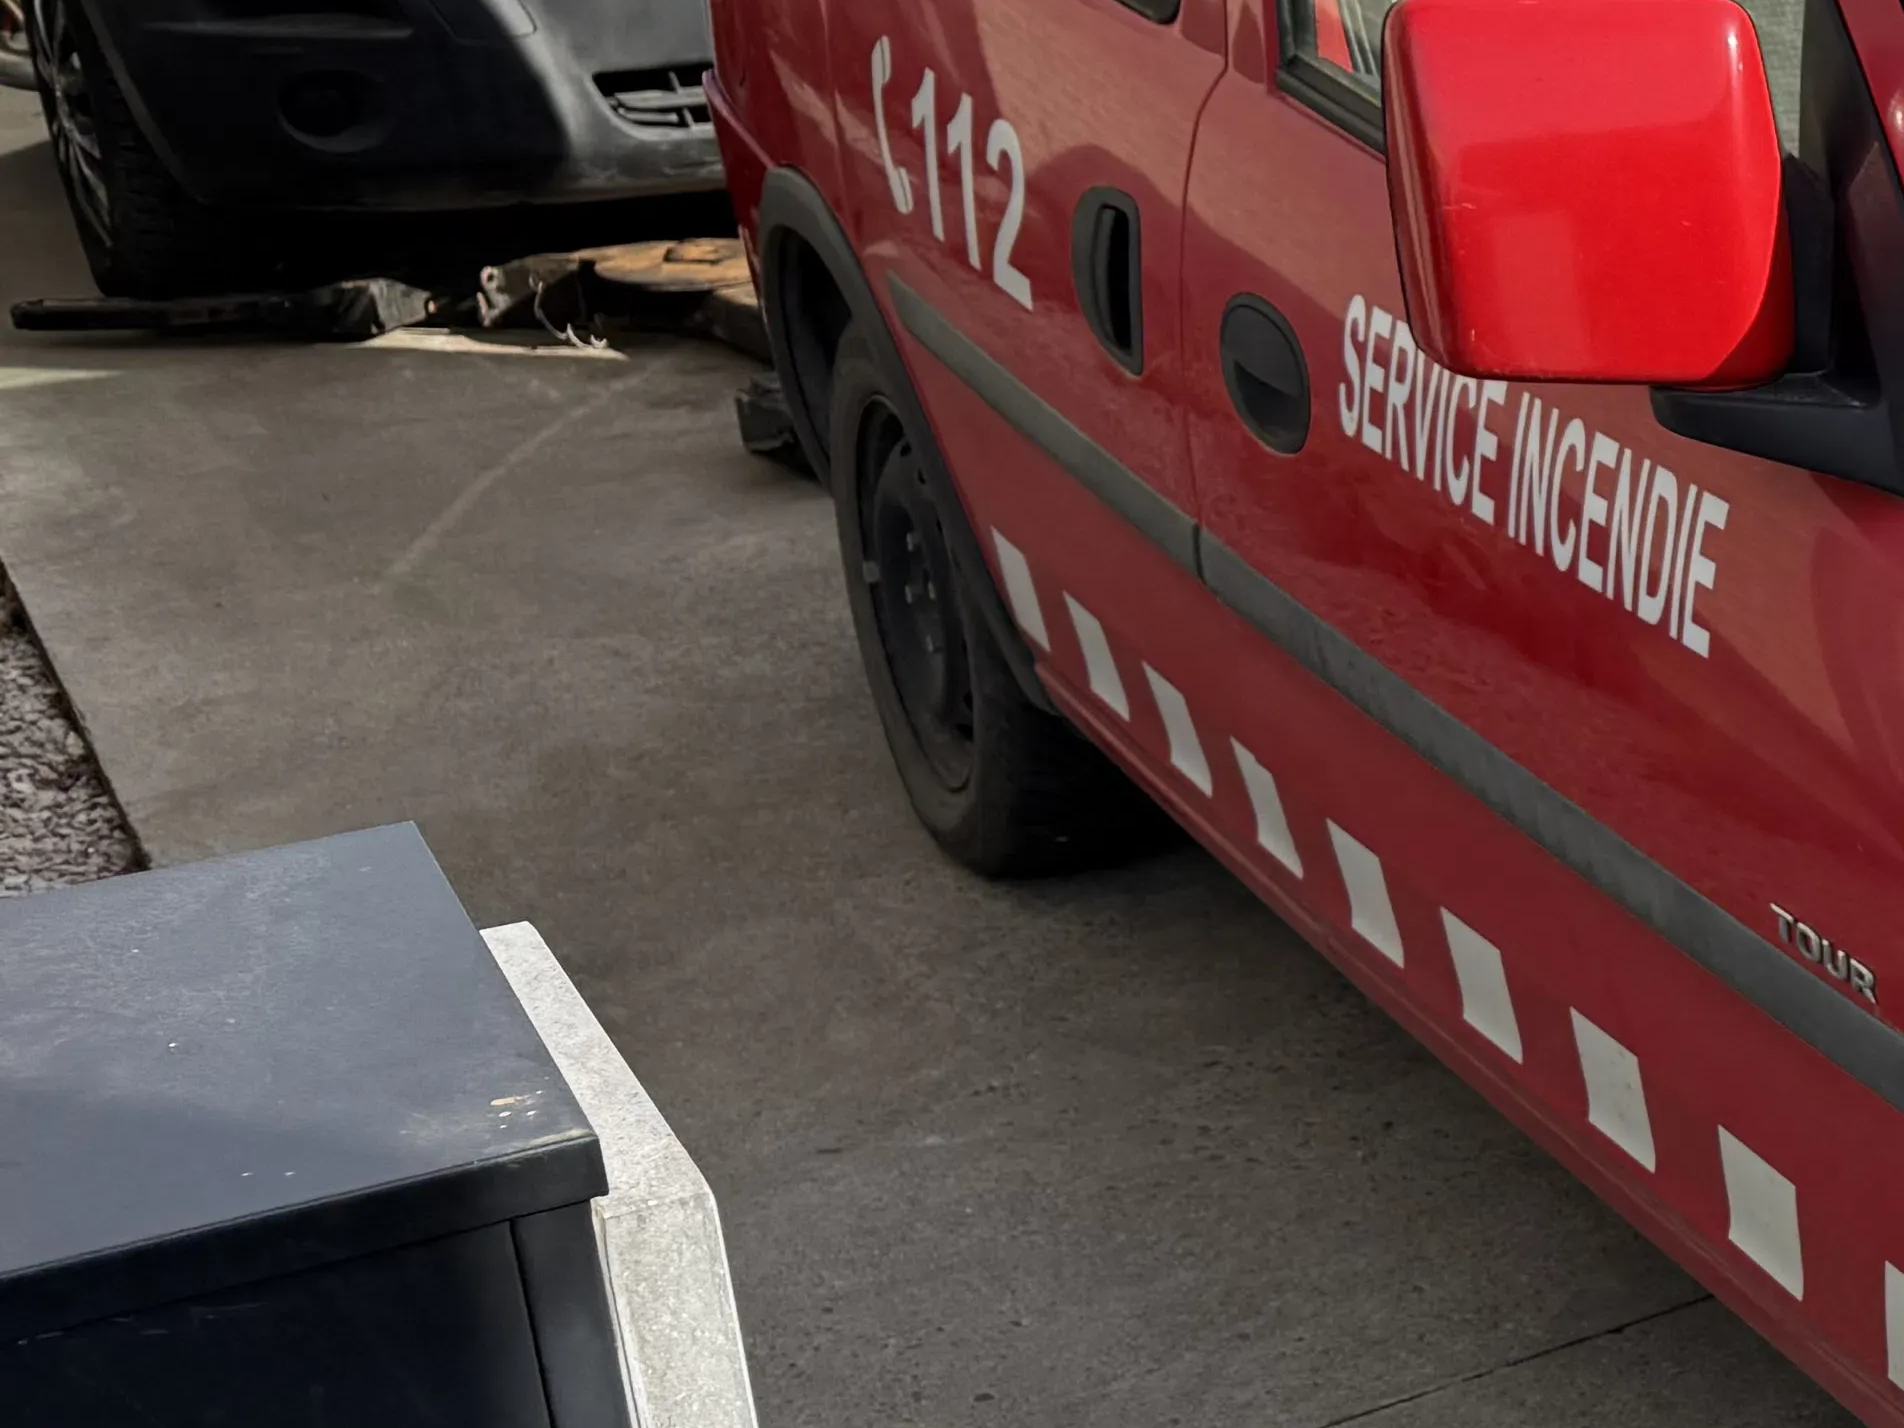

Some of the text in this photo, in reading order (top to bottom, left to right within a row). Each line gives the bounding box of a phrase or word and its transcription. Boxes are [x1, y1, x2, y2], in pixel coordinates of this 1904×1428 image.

[911, 66, 1034, 312] 112
[1339, 293, 1730, 659] SERVICE INCENDIE
[1769, 902, 1878, 1005] TOUR
